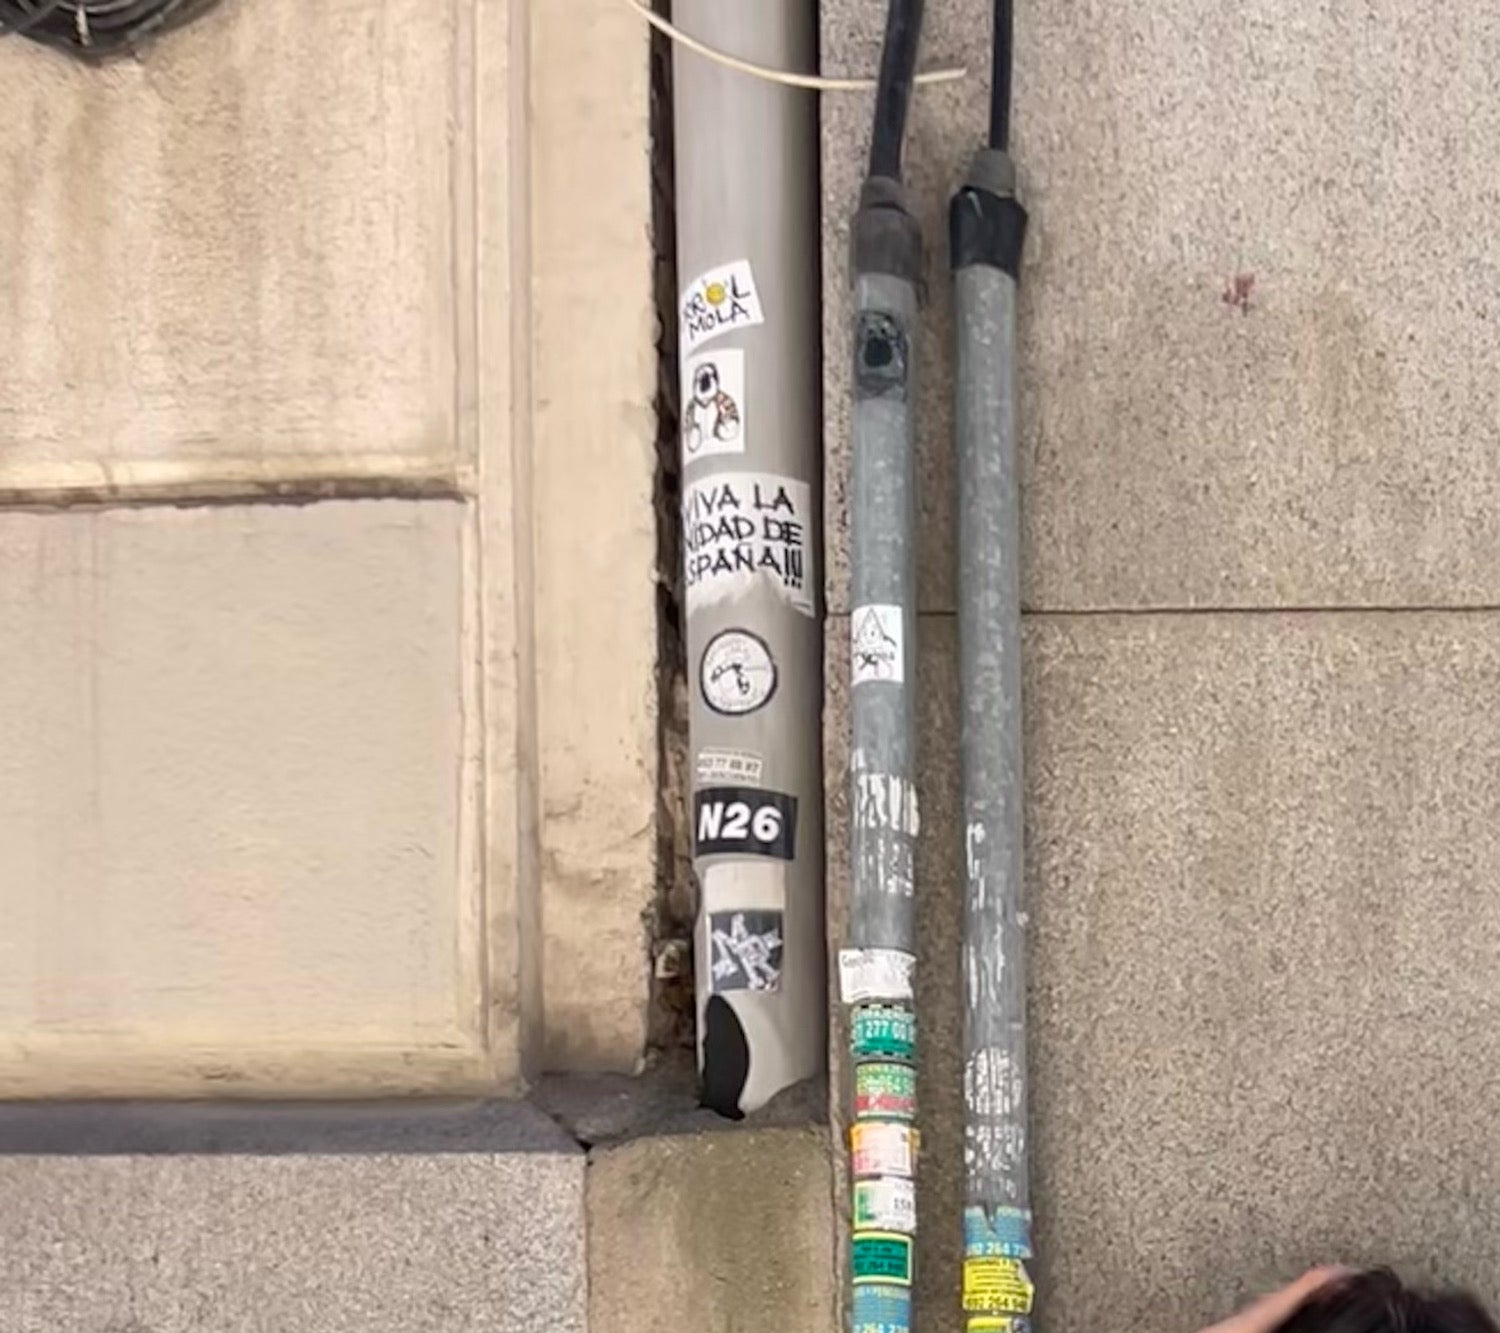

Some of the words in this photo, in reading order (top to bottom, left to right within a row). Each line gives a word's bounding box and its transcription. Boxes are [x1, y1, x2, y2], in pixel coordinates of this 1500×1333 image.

[753, 483, 795, 515] LA
[763, 516, 803, 546] DE
[687, 541, 803, 590] SPAÑA!!!
[698, 801, 783, 843] N26
